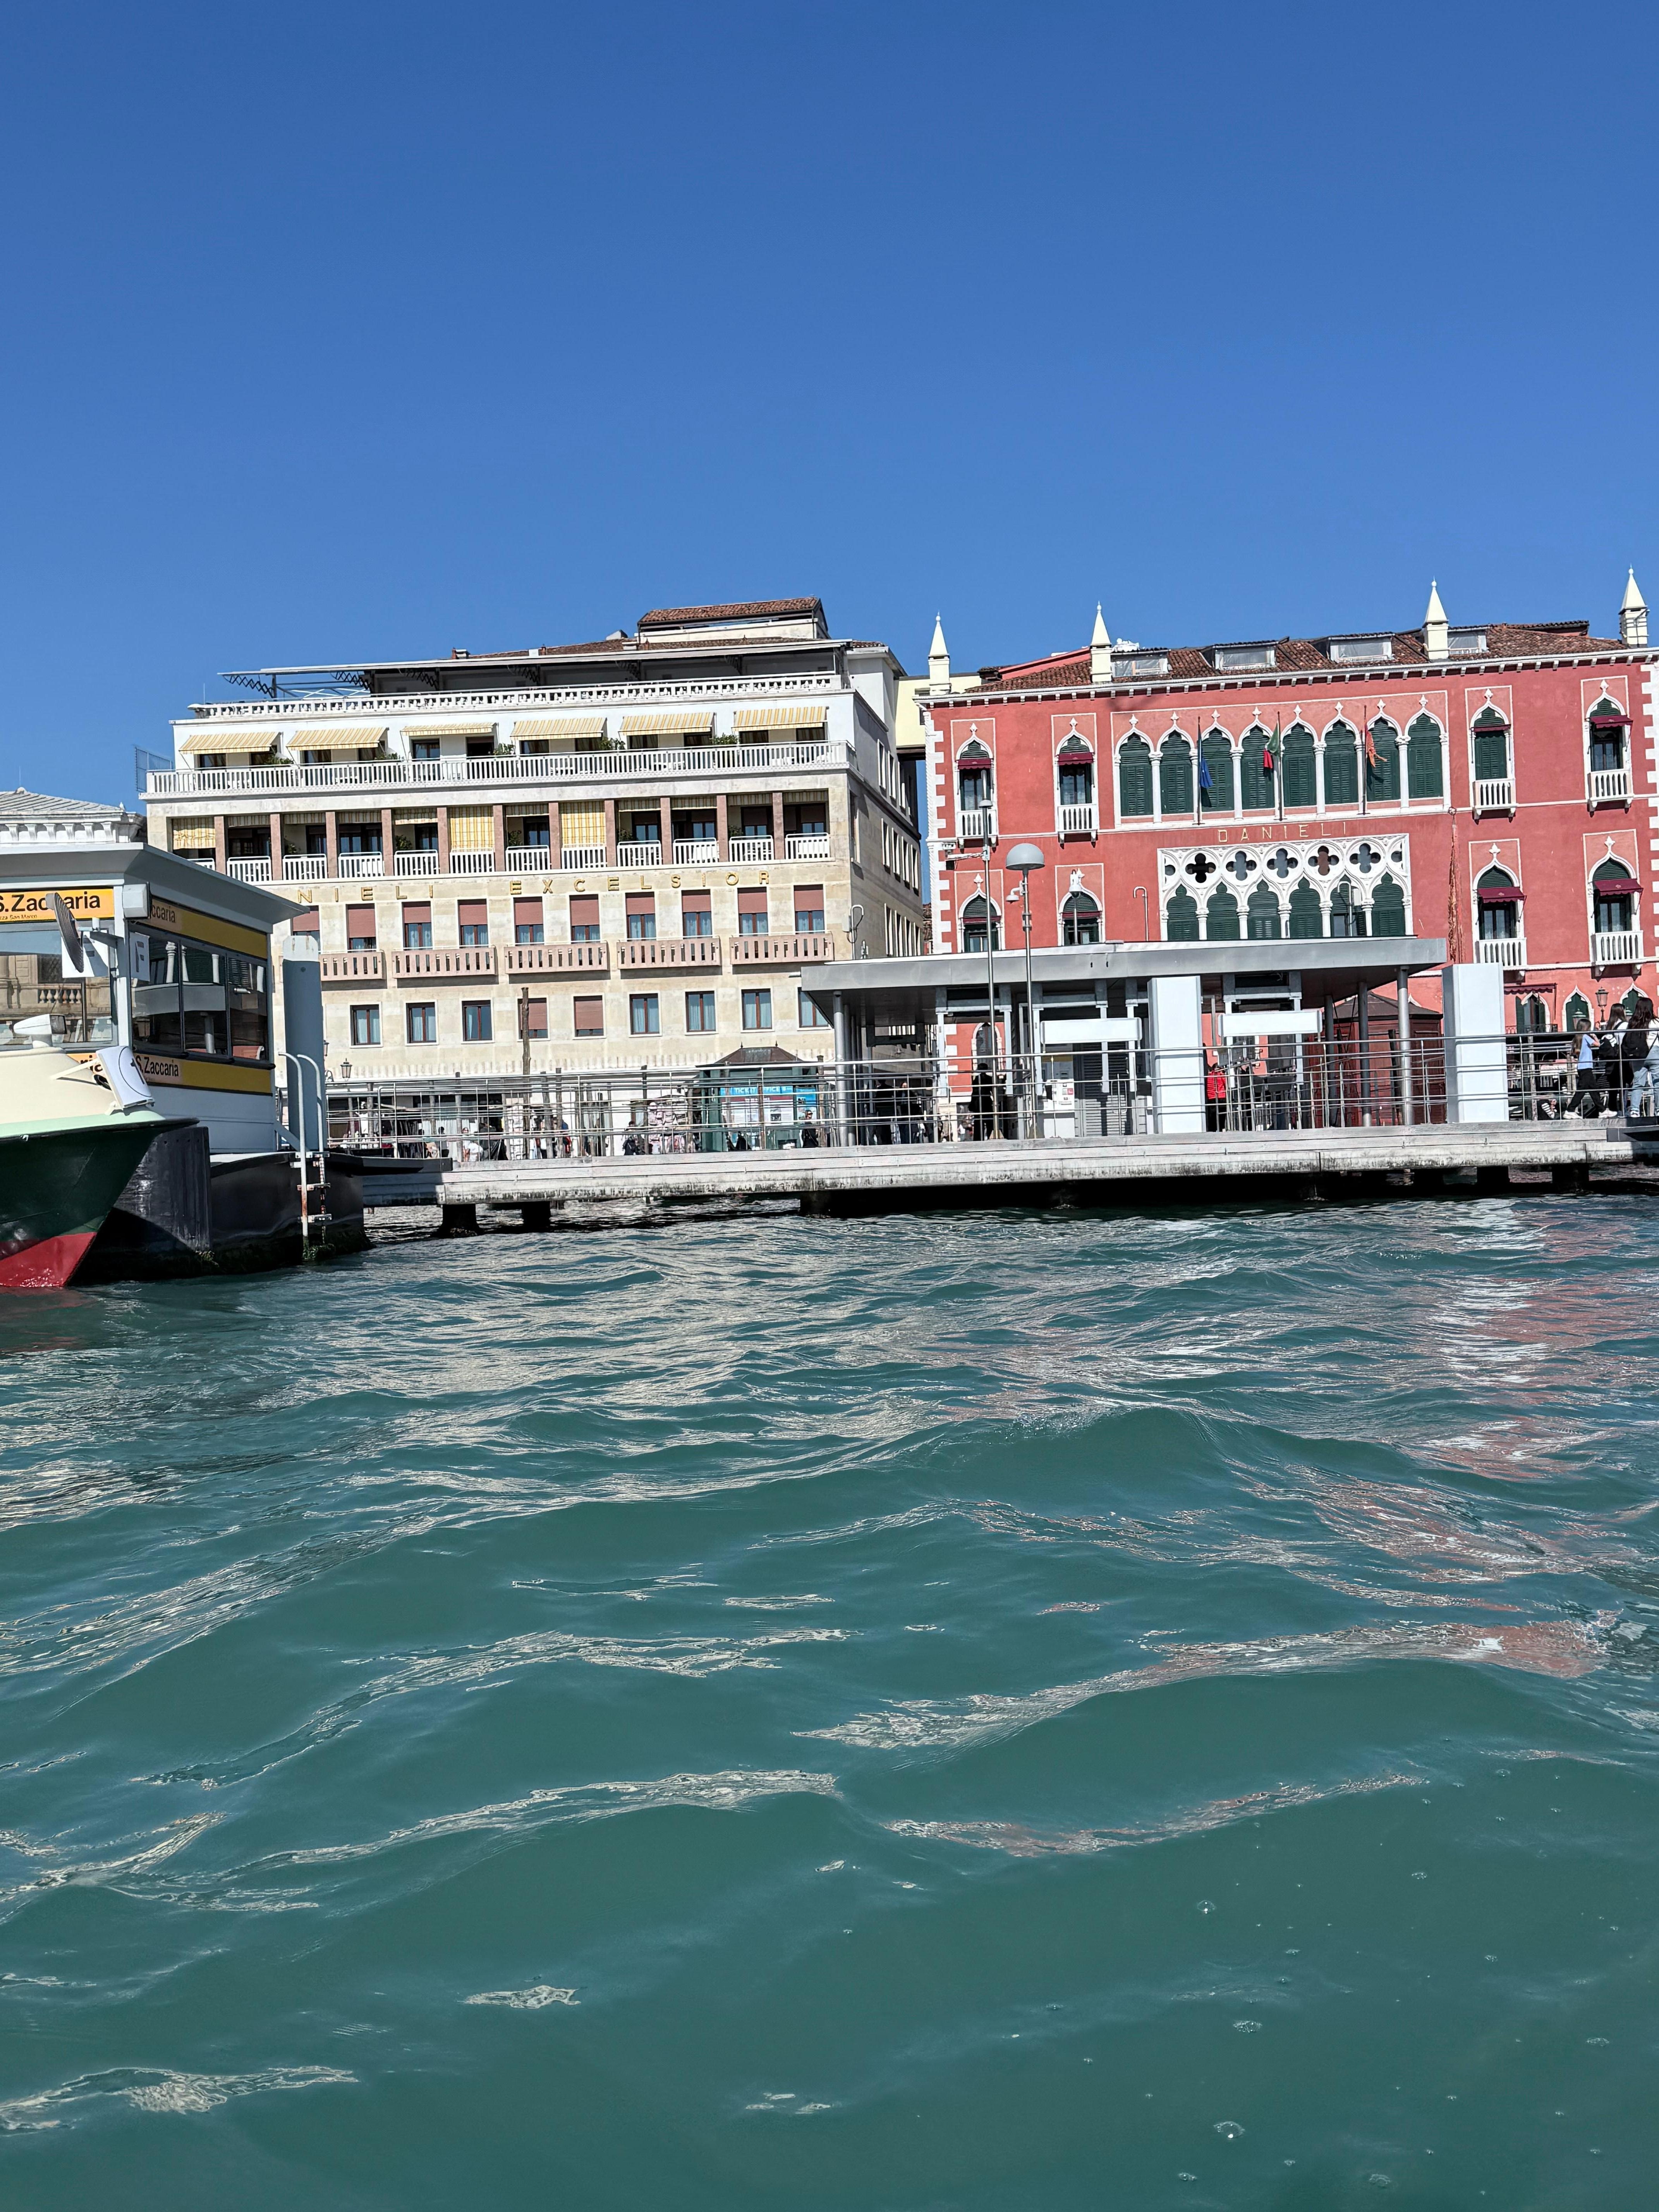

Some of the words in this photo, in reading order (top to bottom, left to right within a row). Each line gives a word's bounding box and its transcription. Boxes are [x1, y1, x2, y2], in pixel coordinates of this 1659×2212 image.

[1218, 822, 1346, 842] DANIELI
[510, 871, 769, 895] EXCELSIOR
[0, 891, 100, 912] .Zacaria
